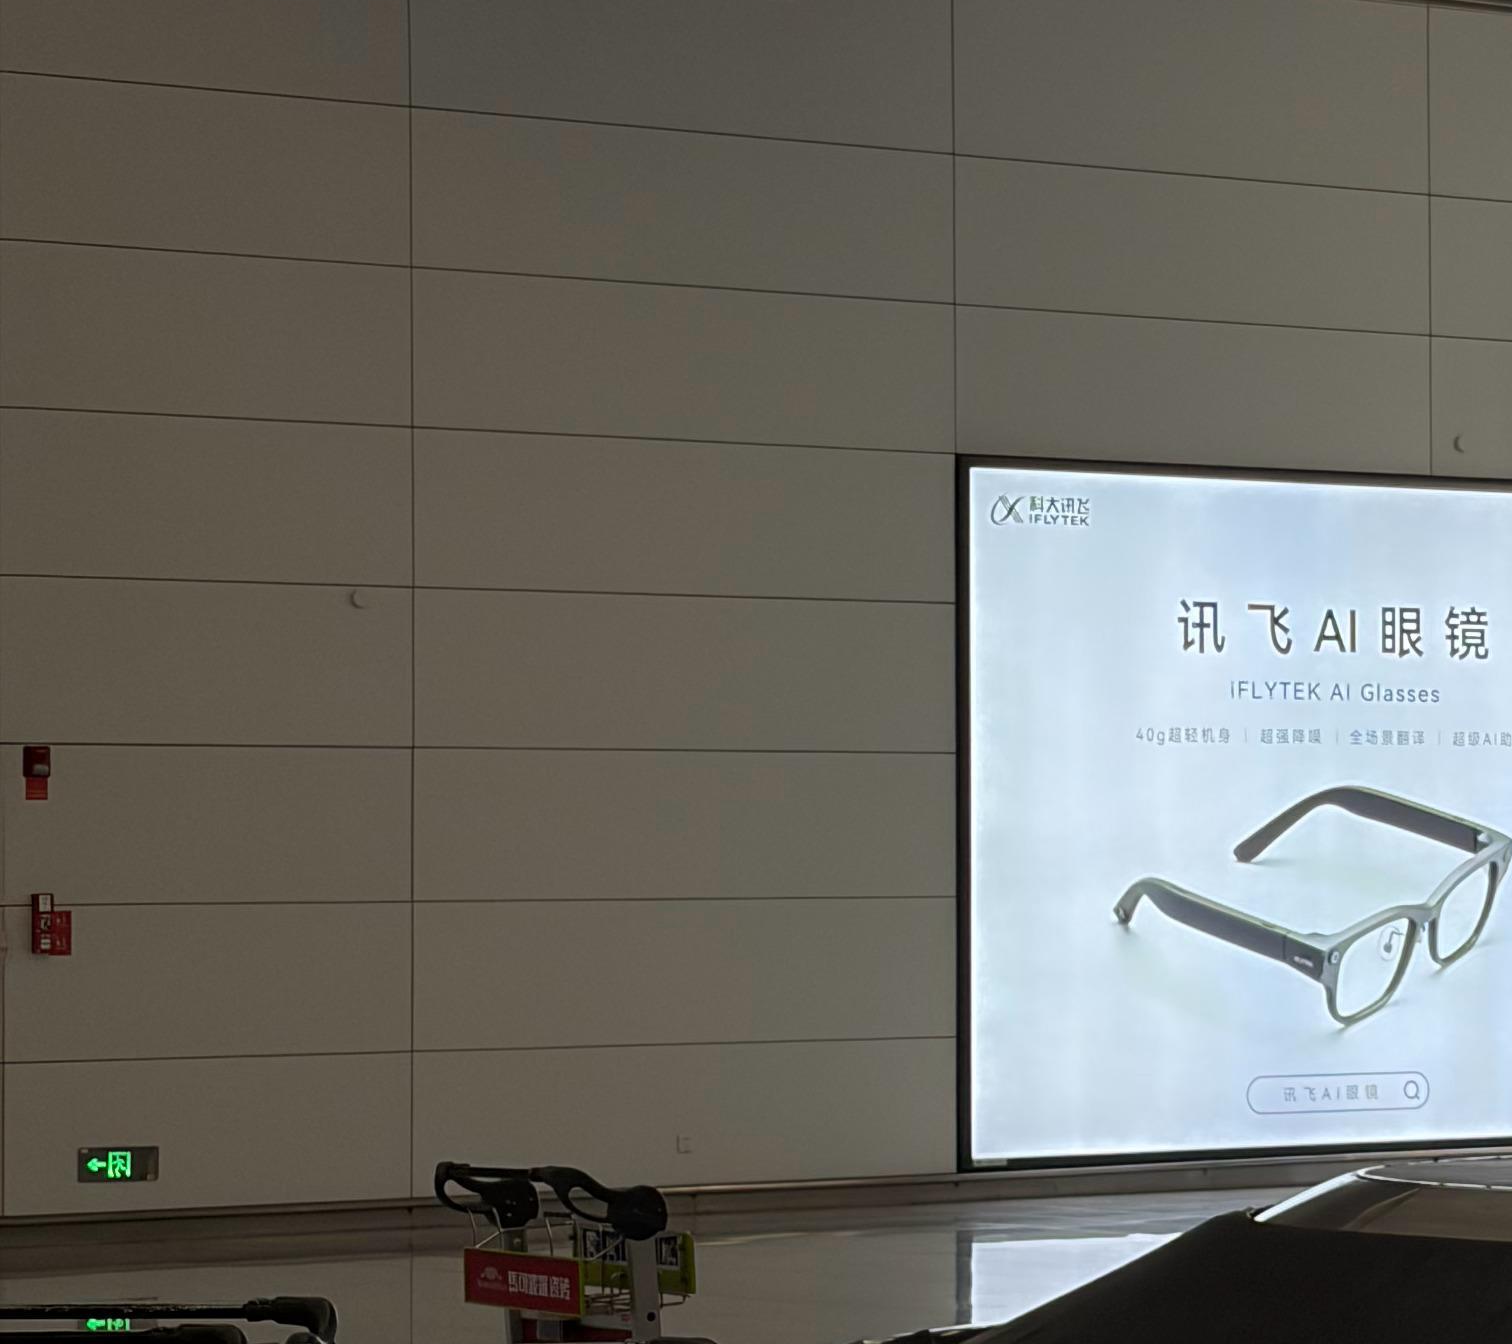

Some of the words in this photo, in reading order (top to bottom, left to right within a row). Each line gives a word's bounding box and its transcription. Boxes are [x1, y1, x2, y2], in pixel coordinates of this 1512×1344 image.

[1029, 495, 1090, 515] 科大讯飞
[1230, 679, 1322, 702] iFLYTEK
[1330, 682, 1351, 702] AI
[1360, 683, 1441, 704] Glasses
[1135, 727, 1231, 747] 40g超轻机身
